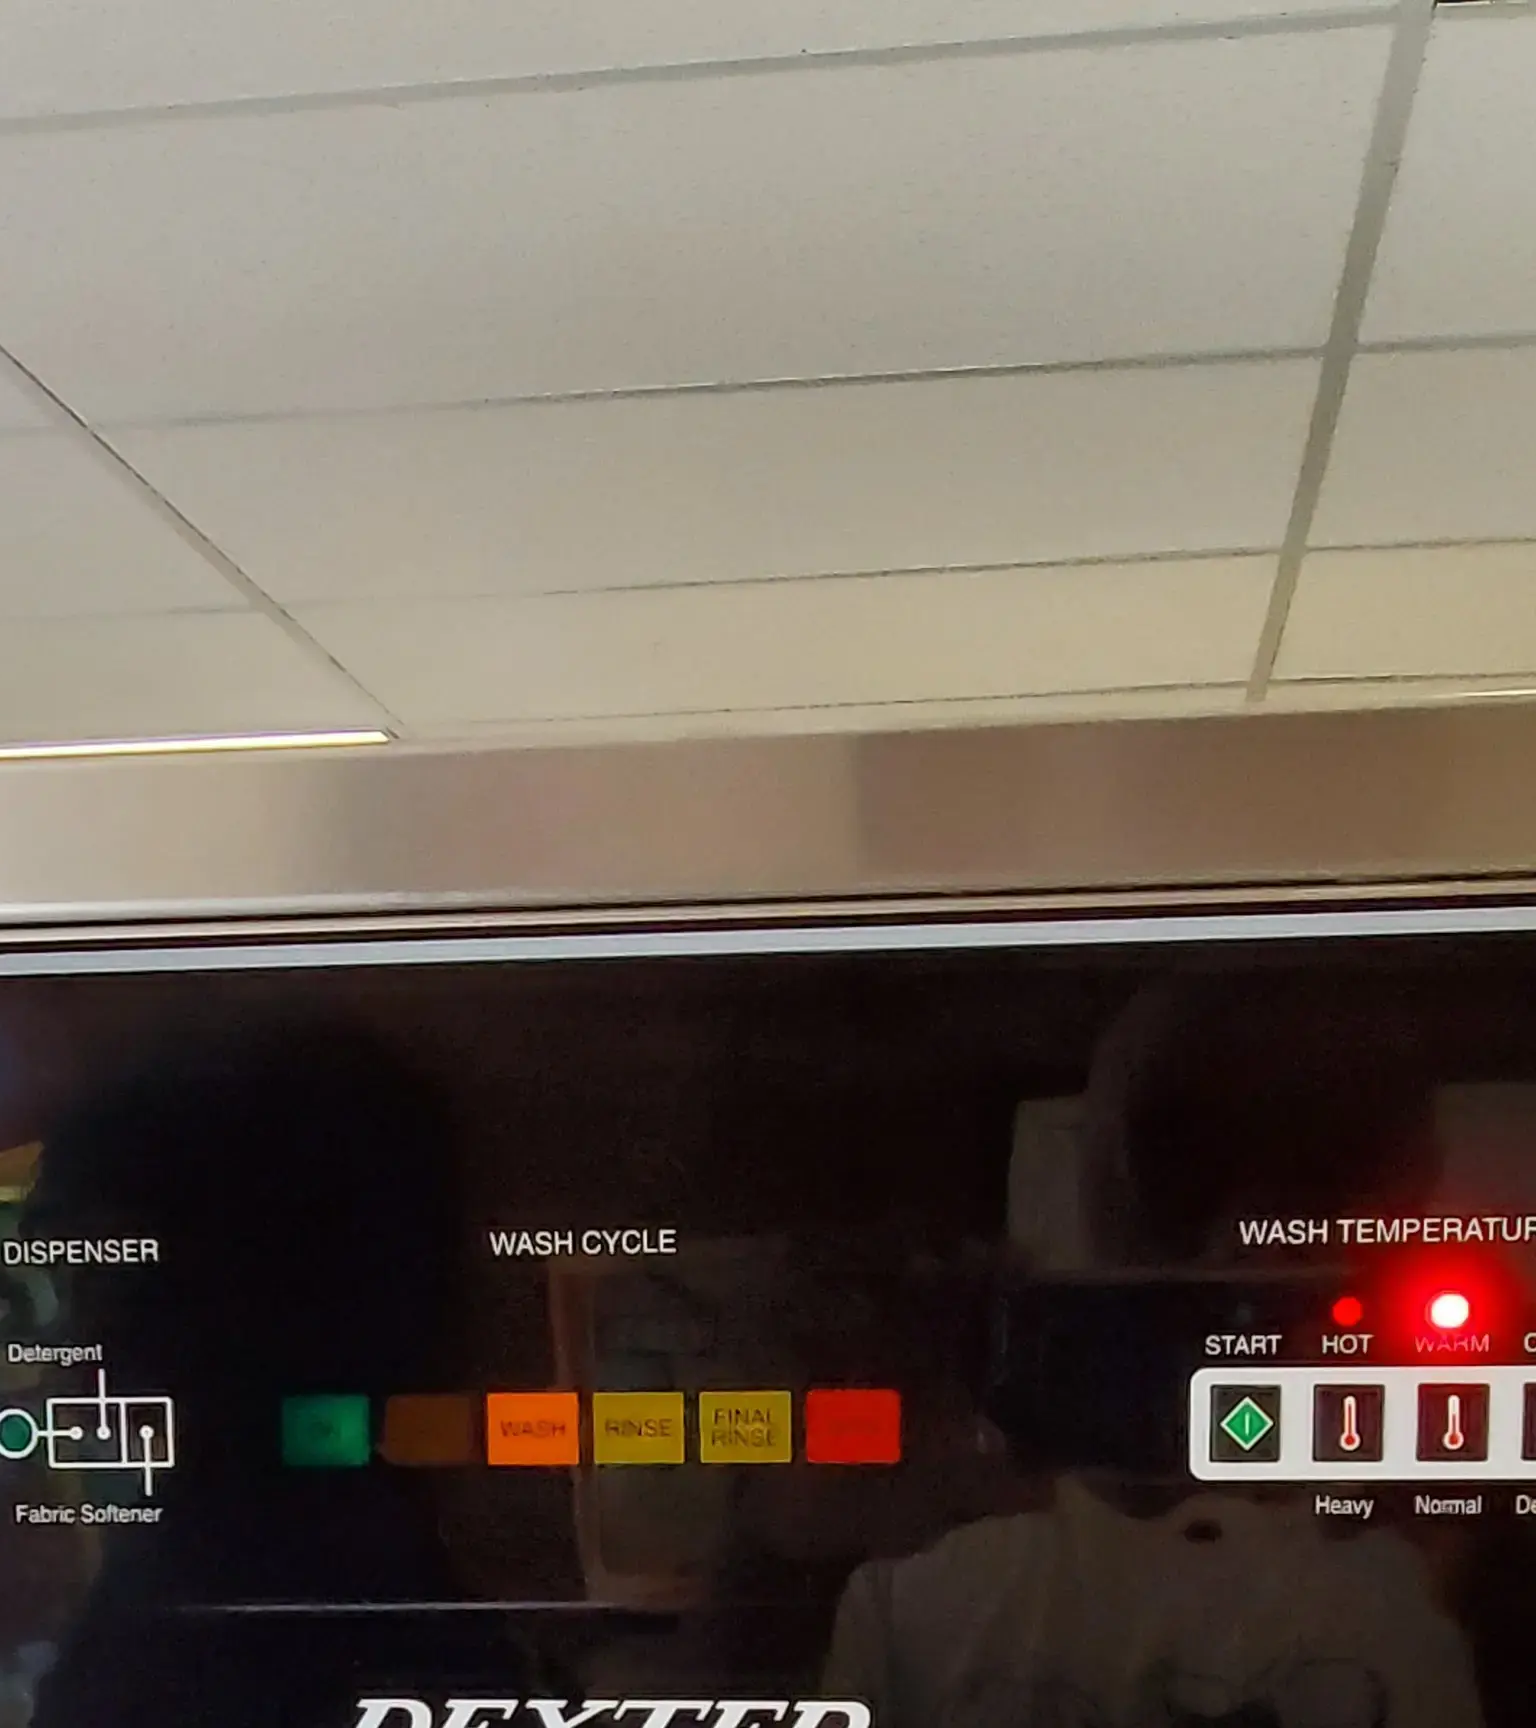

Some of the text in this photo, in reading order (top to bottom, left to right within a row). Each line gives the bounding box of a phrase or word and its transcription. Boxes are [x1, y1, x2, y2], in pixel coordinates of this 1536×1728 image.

[489, 1229, 677, 1257] WASH CYCLE
[1239, 1219, 1329, 1246] WASH
[2, 1239, 160, 1265] DISPENSER
[7, 1343, 103, 1366] Detergent
[1205, 1334, 1282, 1356] START
[1322, 1333, 1374, 1354] HOT
[1414, 1334, 1491, 1354] WARM
[604, 1418, 673, 1438] RINSE
[713, 1407, 774, 1426] FINAL
[500, 1419, 567, 1438] WASH
[711, 1428, 777, 1448] RINSE
[15, 1503, 164, 1524] Fabric Softener
[1314, 1494, 1374, 1519] Heavy
[1415, 1494, 1482, 1516] Normal
